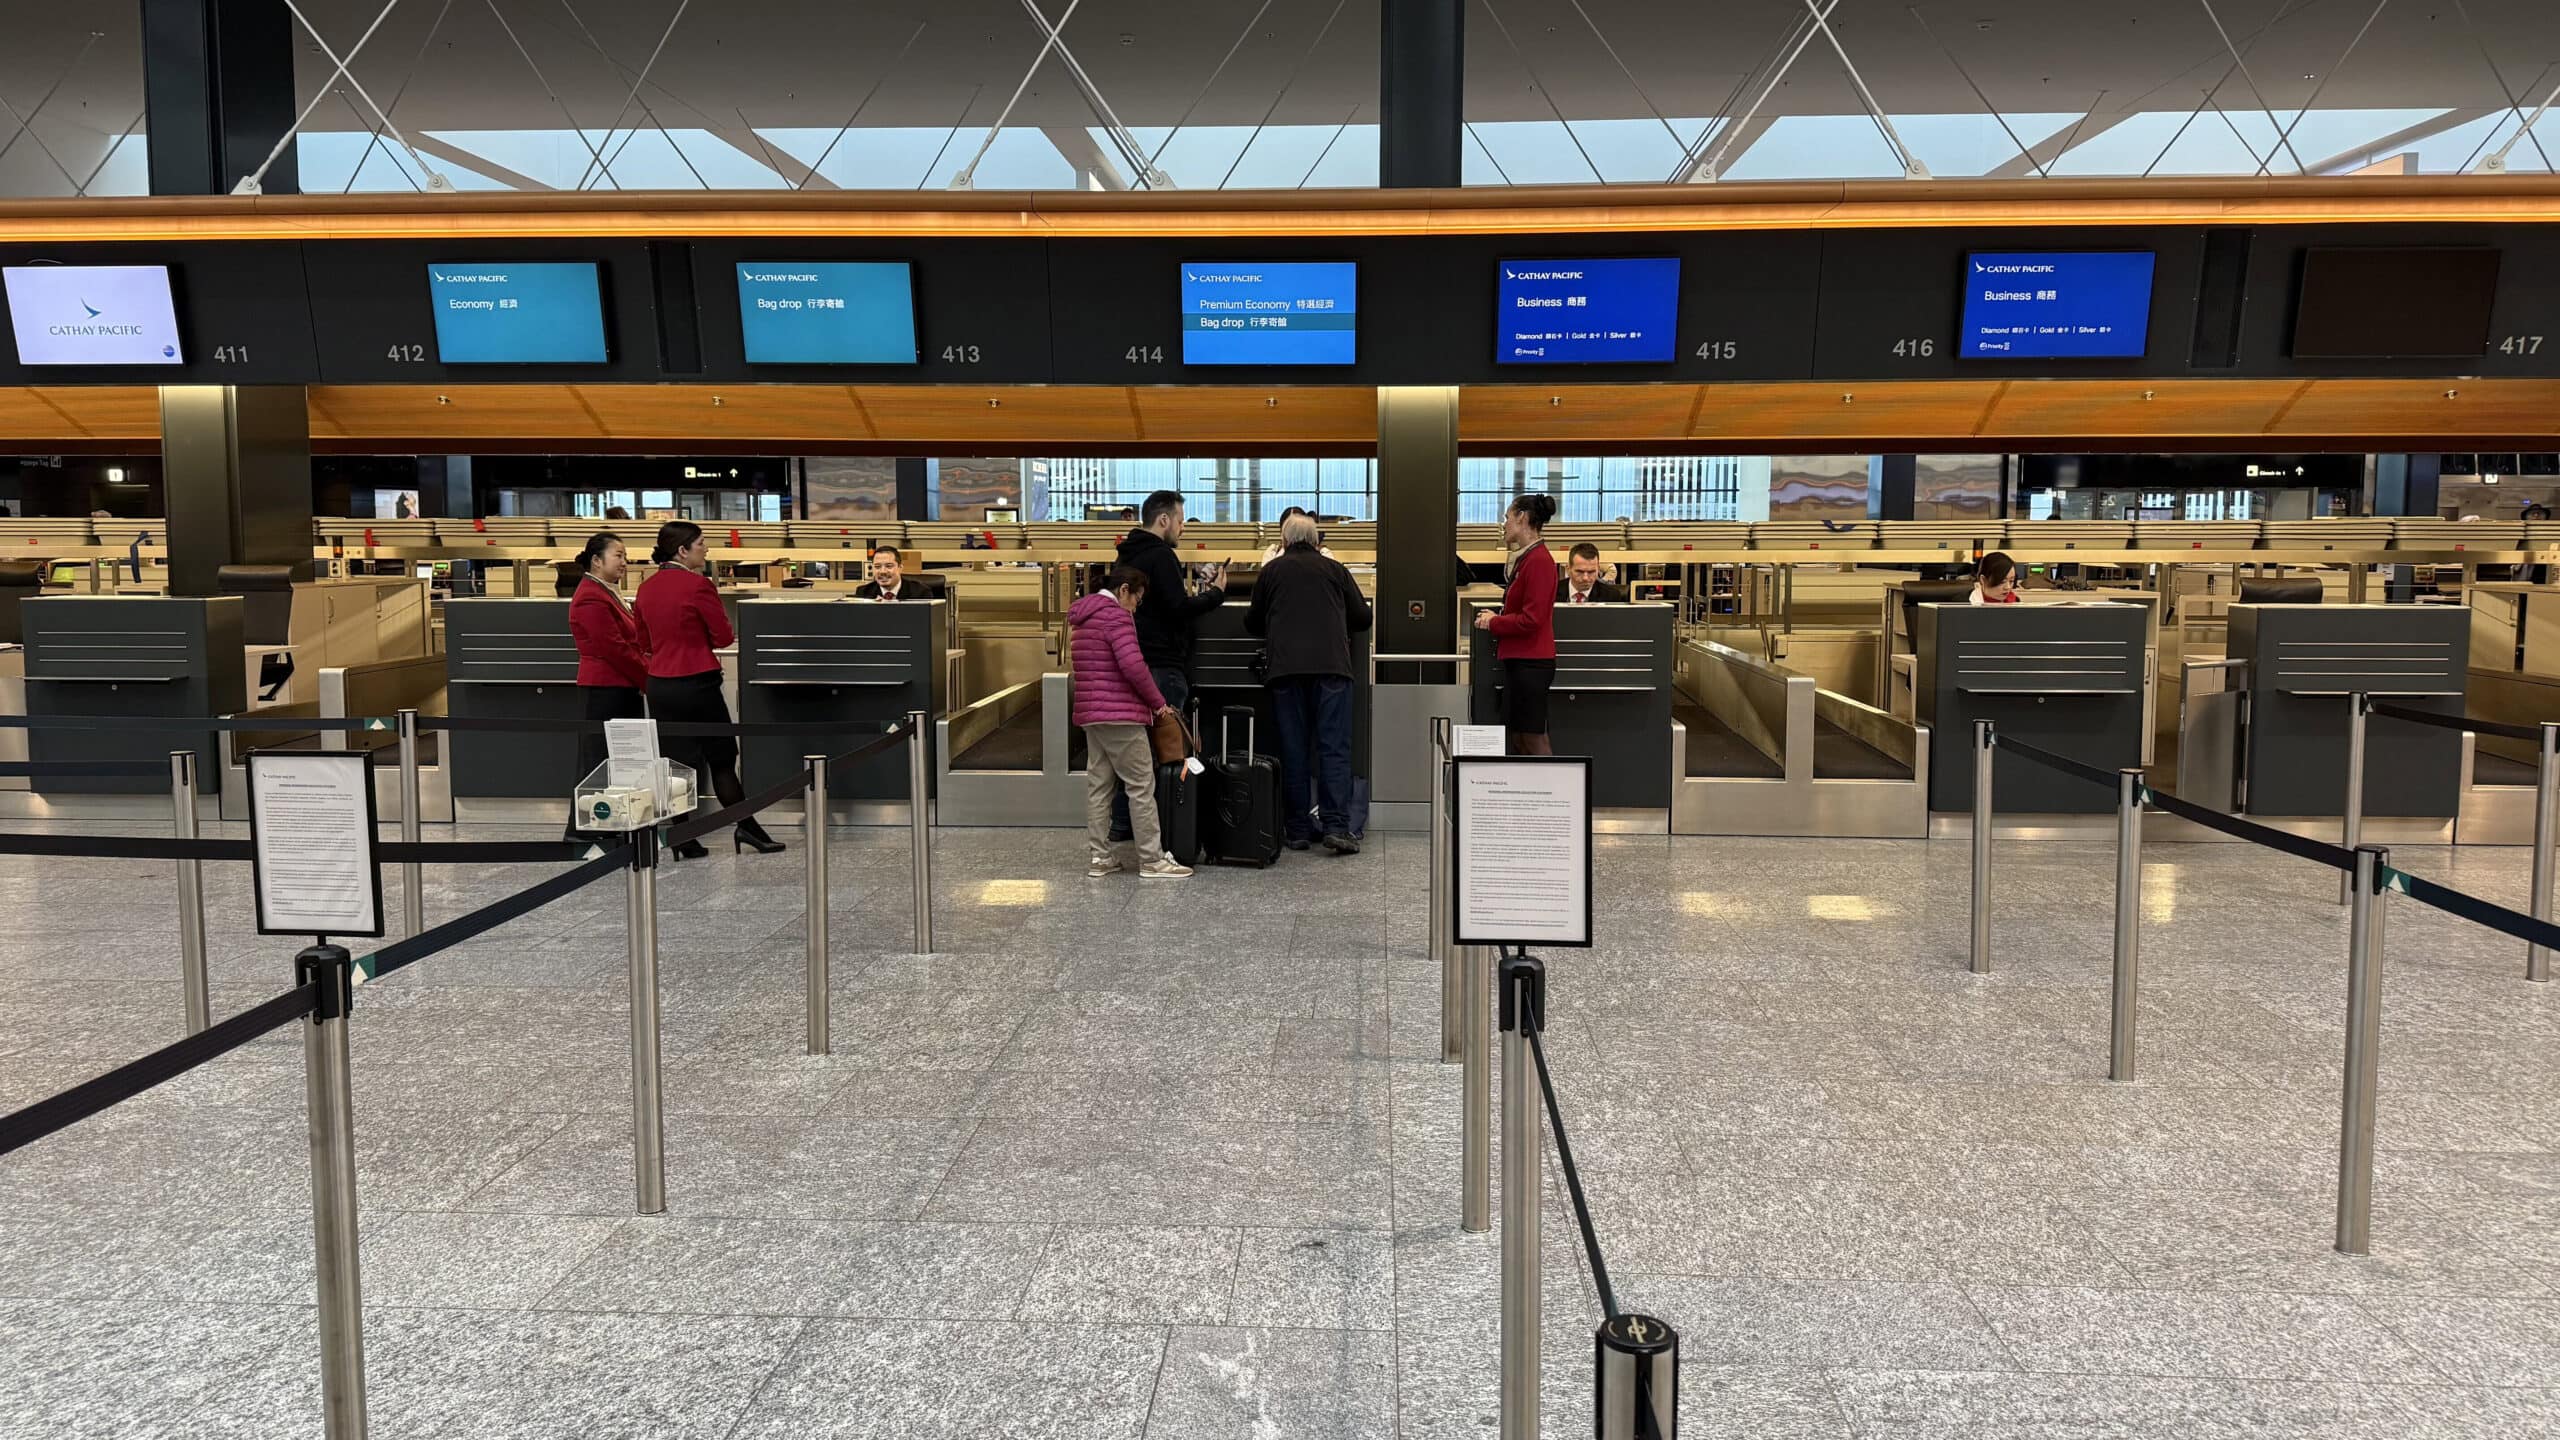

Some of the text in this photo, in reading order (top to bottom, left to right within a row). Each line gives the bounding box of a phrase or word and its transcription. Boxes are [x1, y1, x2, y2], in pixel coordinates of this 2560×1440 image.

[1986, 265, 2055, 273] CATHAY PACIFIC
[446, 274, 508, 283] CATHAY PACIFIC
[754, 274, 819, 282] CATHAY PACIFIC
[1199, 274, 1263, 283] CATHAY PACIFIC
[1517, 271, 1583, 280] CATHAY PACIFIC
[1985, 291, 2031, 300] Business
[450, 299, 494, 310] Economy
[758, 299, 777, 310] Bag
[779, 299, 802, 310] drop
[1200, 300, 1244, 310] Premium
[1246, 300, 1291, 311] Economy
[1517, 297, 1562, 307] Business
[1201, 318, 1219, 329] Bag
[1221, 318, 1244, 328] drop
[50, 326, 142, 335] CATHAY PACIFIC
[1515, 332, 1544, 340] Diamond
[1571, 332, 1587, 340] Gold
[1609, 331, 1628, 339] Silver
[1980, 327, 2010, 335] Diamond
[2039, 326, 2055, 334] Gold
[1696, 342, 1736, 359] 415
[1893, 339, 1933, 356] 416
[2500, 336, 2543, 354] 417
[214, 346, 248, 362] 411
[388, 345, 424, 361] 412
[942, 346, 980, 363] 413
[1126, 346, 1163, 363] 414
